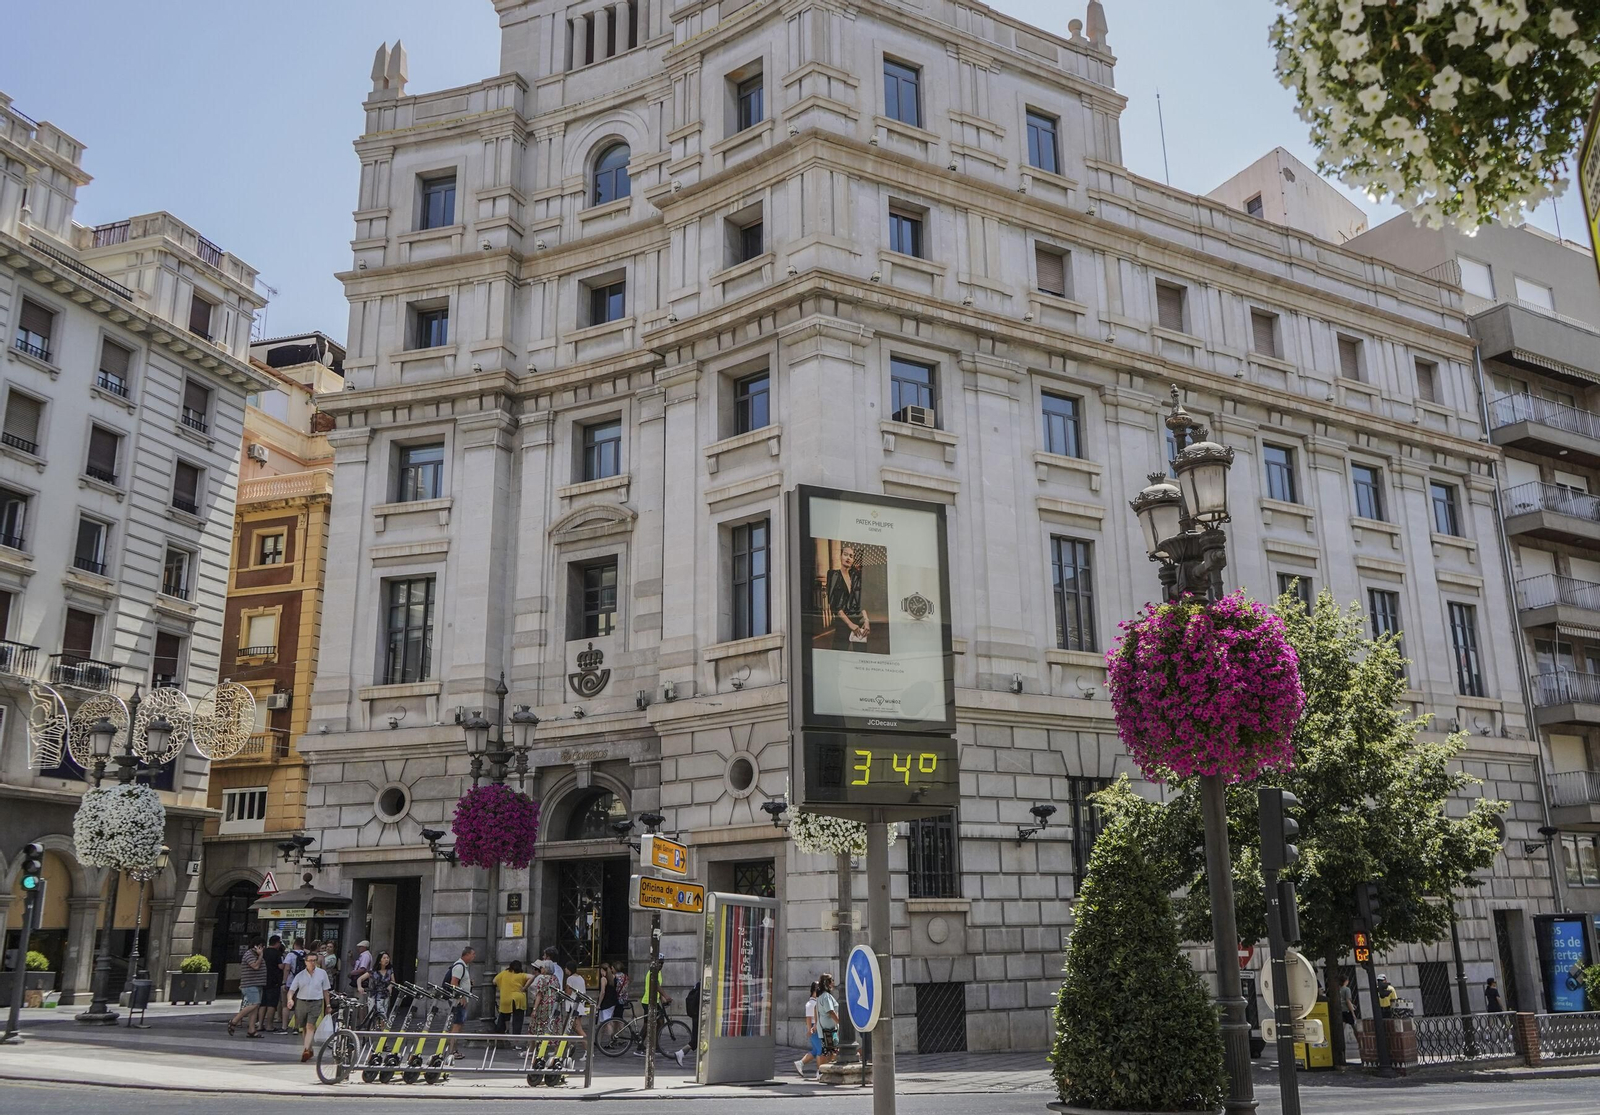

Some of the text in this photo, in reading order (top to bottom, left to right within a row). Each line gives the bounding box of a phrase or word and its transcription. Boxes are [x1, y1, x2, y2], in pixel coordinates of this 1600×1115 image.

[872, 520, 894, 529] PHILIPPE
[867, 719, 897, 727] JCDecaux
[573, 749, 608, 761] CORREOS
[641, 881, 674, 895] Oficina de
[1567, 936, 1581, 948] de
[1356, 948, 1370, 962] 62
